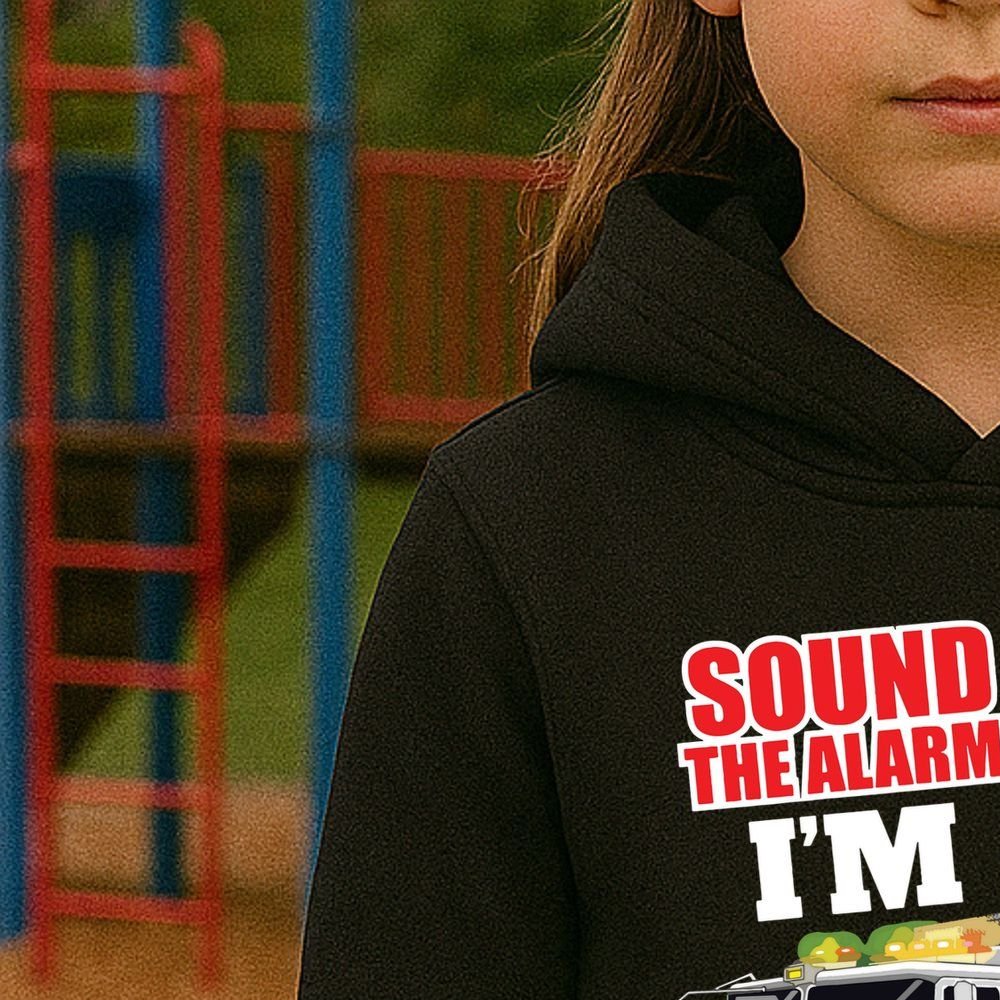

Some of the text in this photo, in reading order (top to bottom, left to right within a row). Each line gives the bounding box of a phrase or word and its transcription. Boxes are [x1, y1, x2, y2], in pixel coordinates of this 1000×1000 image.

[686, 625, 993, 738] SOUND
[683, 740, 794, 805] THE
[748, 802, 963, 922] I'M
